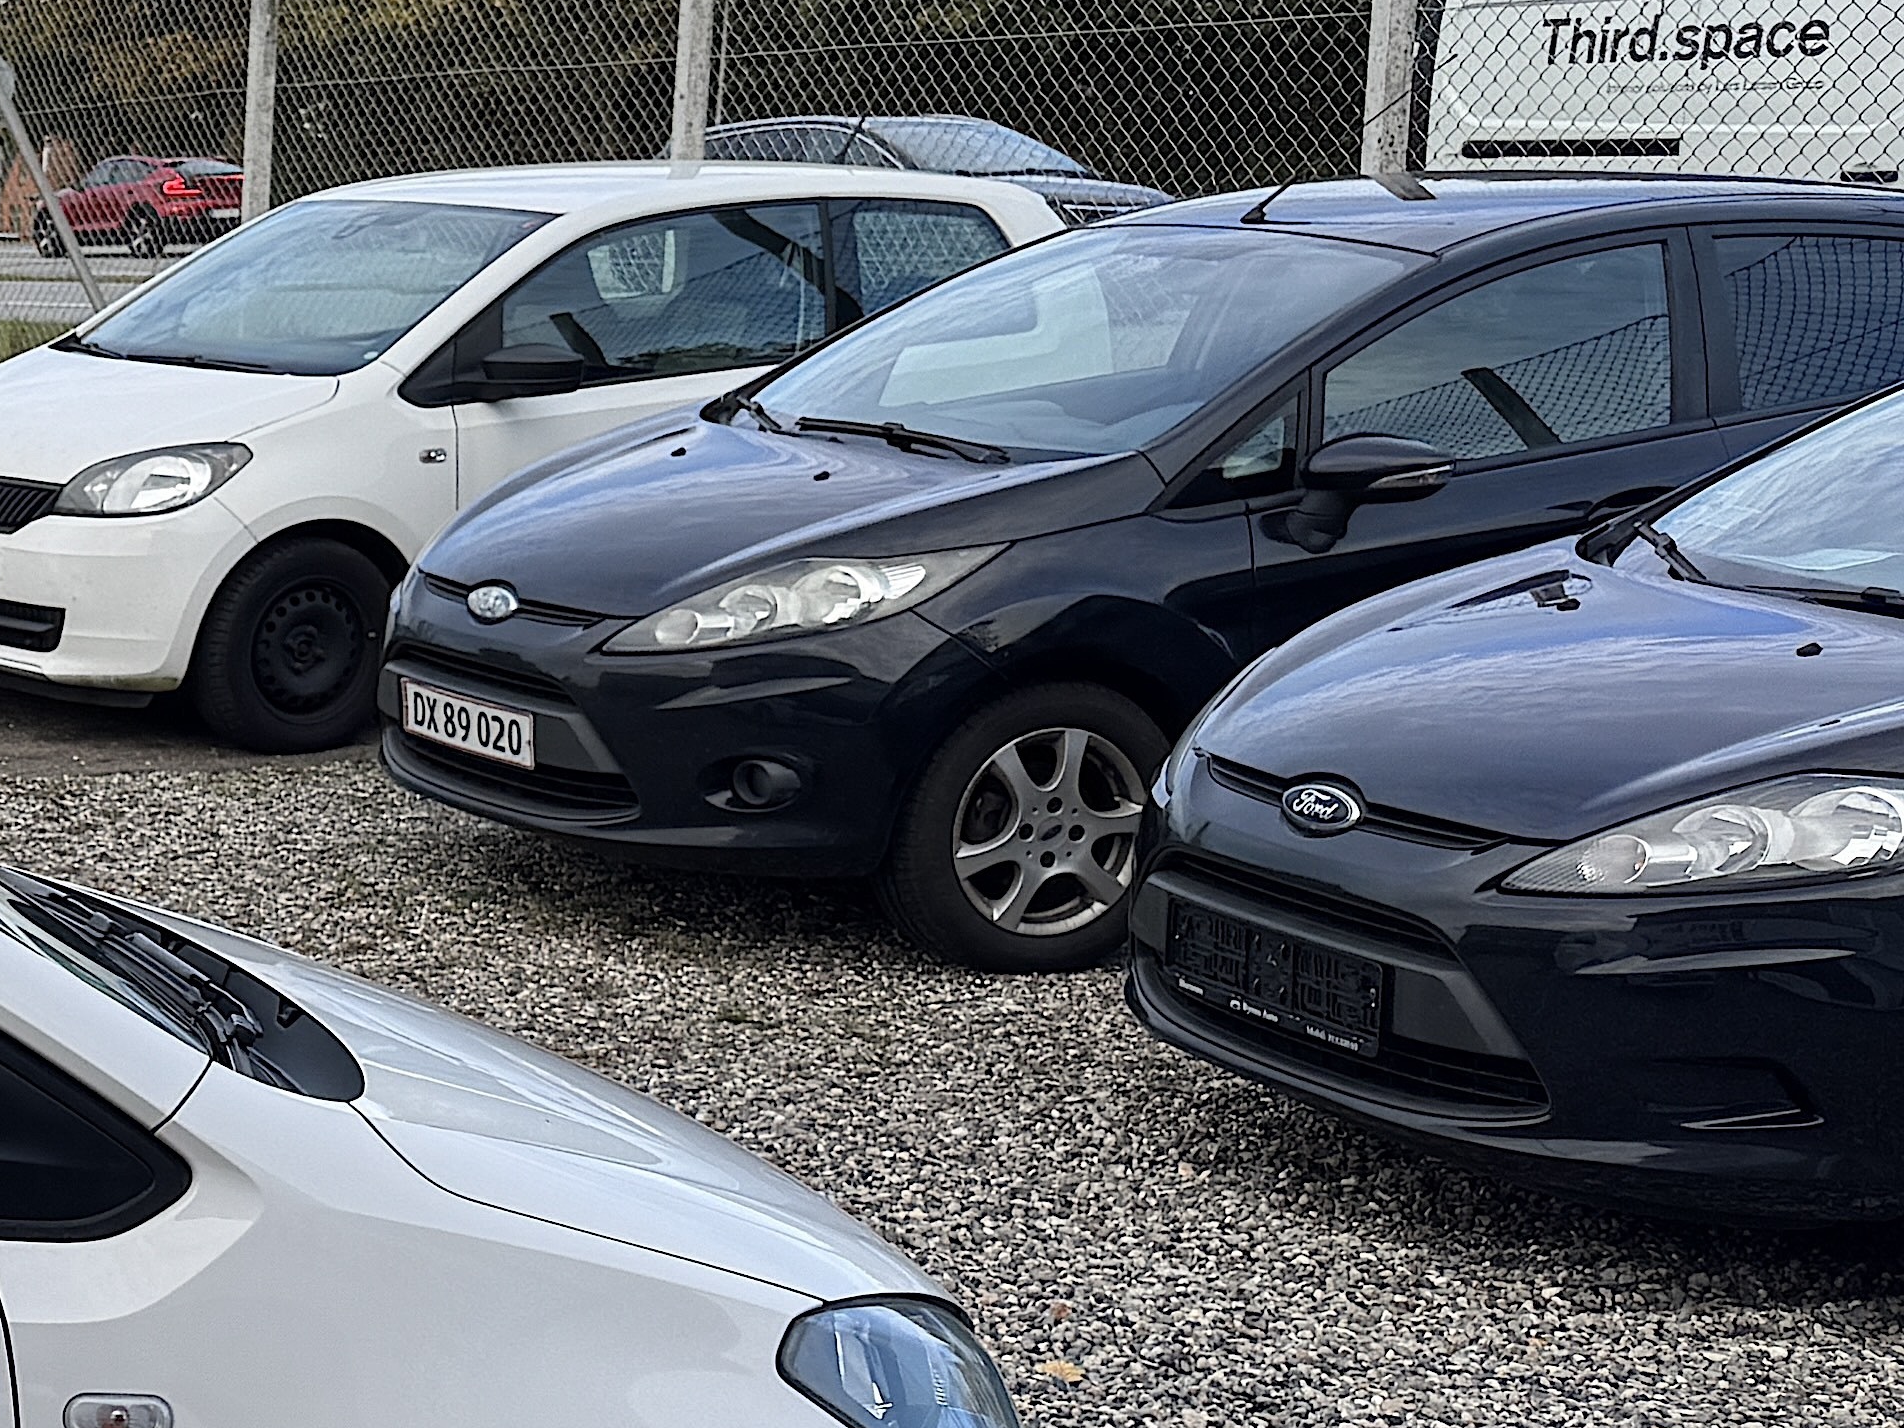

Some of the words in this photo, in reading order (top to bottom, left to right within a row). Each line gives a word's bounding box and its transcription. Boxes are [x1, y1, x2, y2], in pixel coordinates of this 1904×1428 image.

[1542, 14, 1830, 70] Third.space
[413, 691, 439, 733] DX
[443, 701, 471, 742] 89
[477, 711, 522, 756] 020
[1293, 789, 1339, 820] Ford
